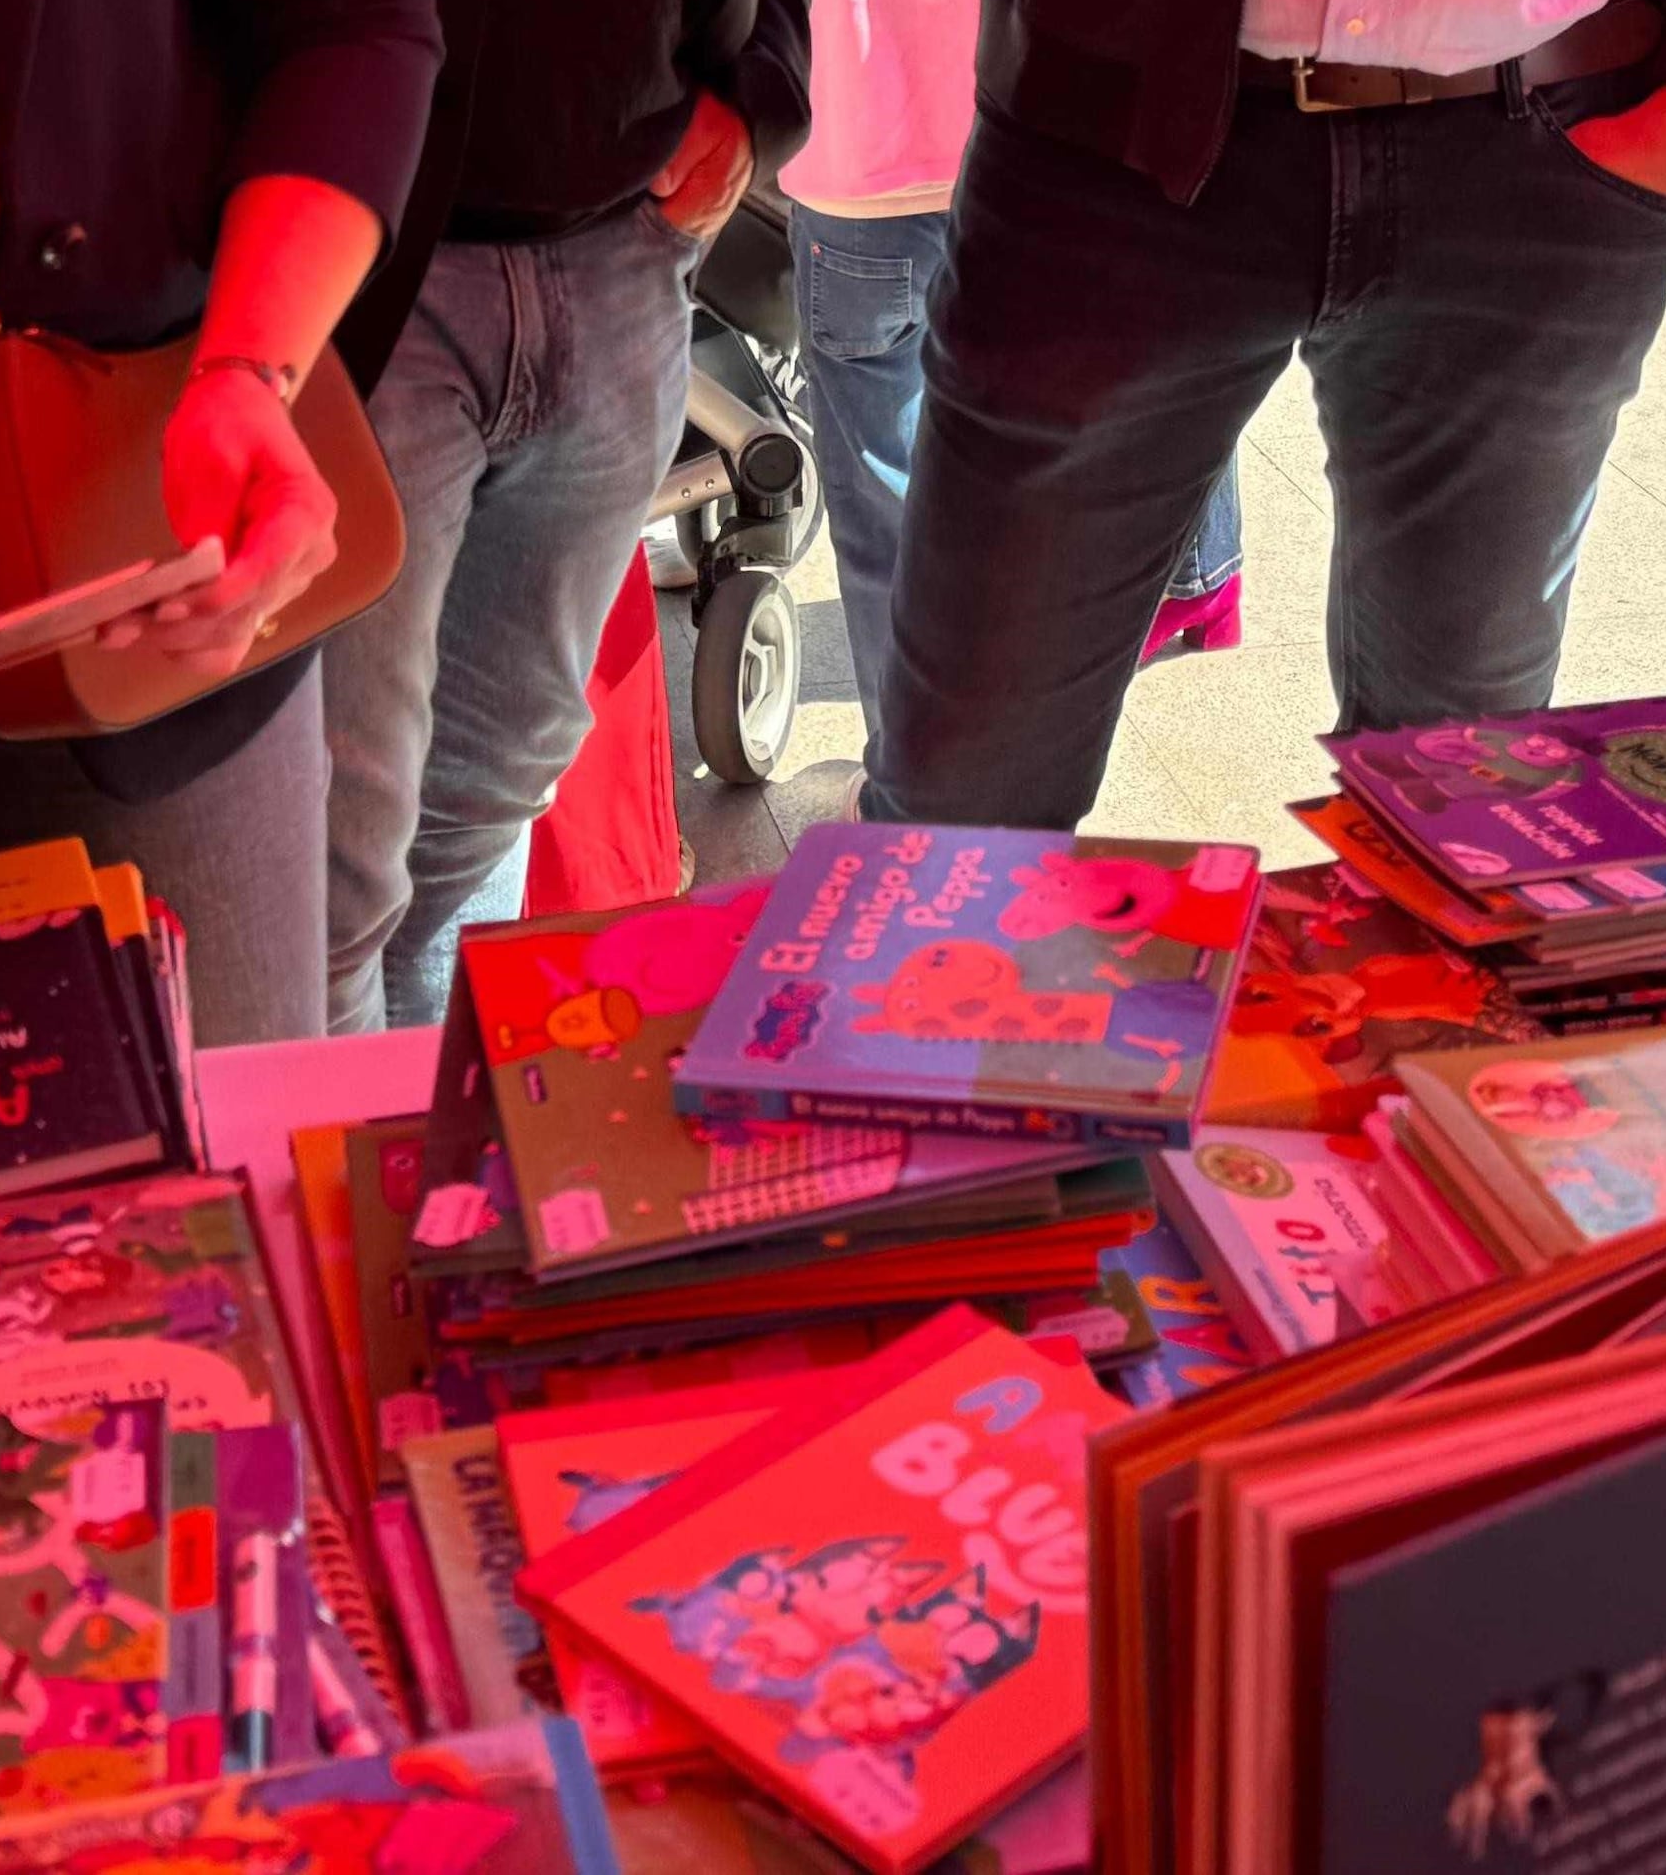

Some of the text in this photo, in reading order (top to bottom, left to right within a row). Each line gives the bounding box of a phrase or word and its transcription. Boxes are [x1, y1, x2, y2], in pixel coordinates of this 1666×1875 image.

[759, 940, 823, 974] El
[798, 852, 865, 940] nuevo
[843, 830, 934, 961] amigo de
[902, 846, 993, 929] Peppa
[954, 1375, 1045, 1435] A
[870, 1421, 1089, 1613] BLUE
